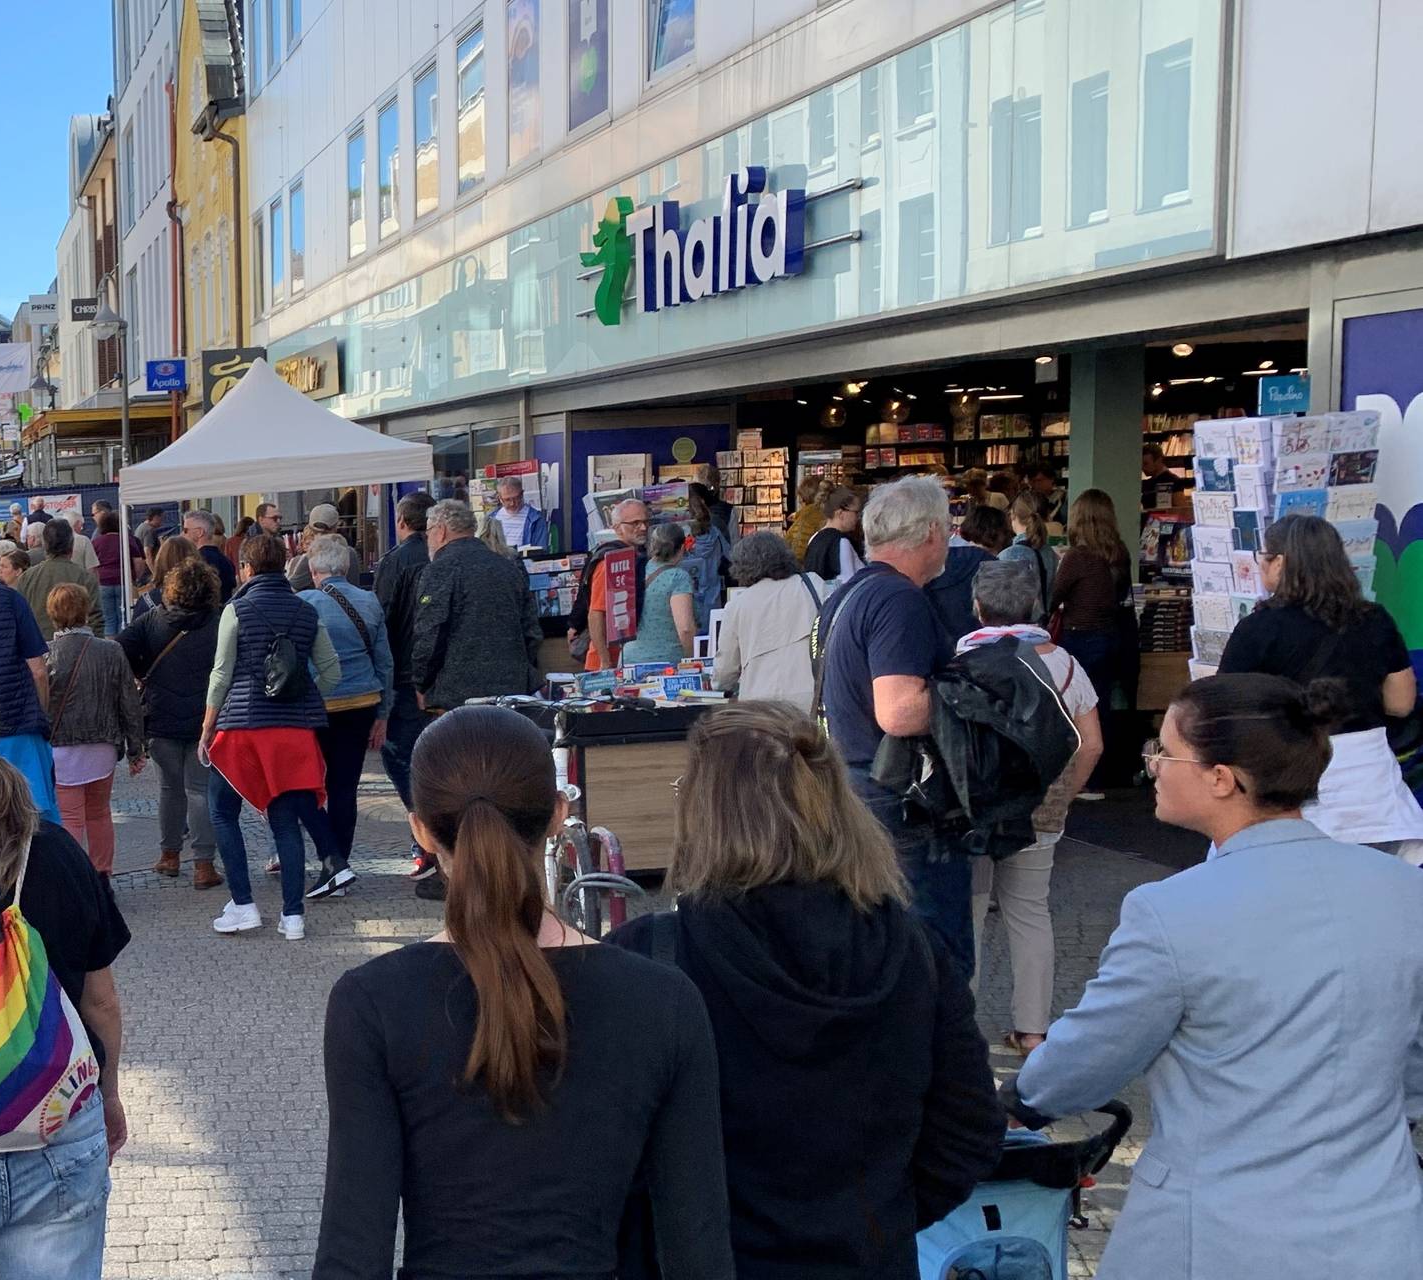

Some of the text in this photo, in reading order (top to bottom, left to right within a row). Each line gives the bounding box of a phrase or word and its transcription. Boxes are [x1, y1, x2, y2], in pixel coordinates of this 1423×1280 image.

[627, 166, 790, 313] Thalia
[31, 303, 57, 311] PRINZ
[73, 305, 98, 315] CHRIS
[152, 378, 181, 392] Apollo
